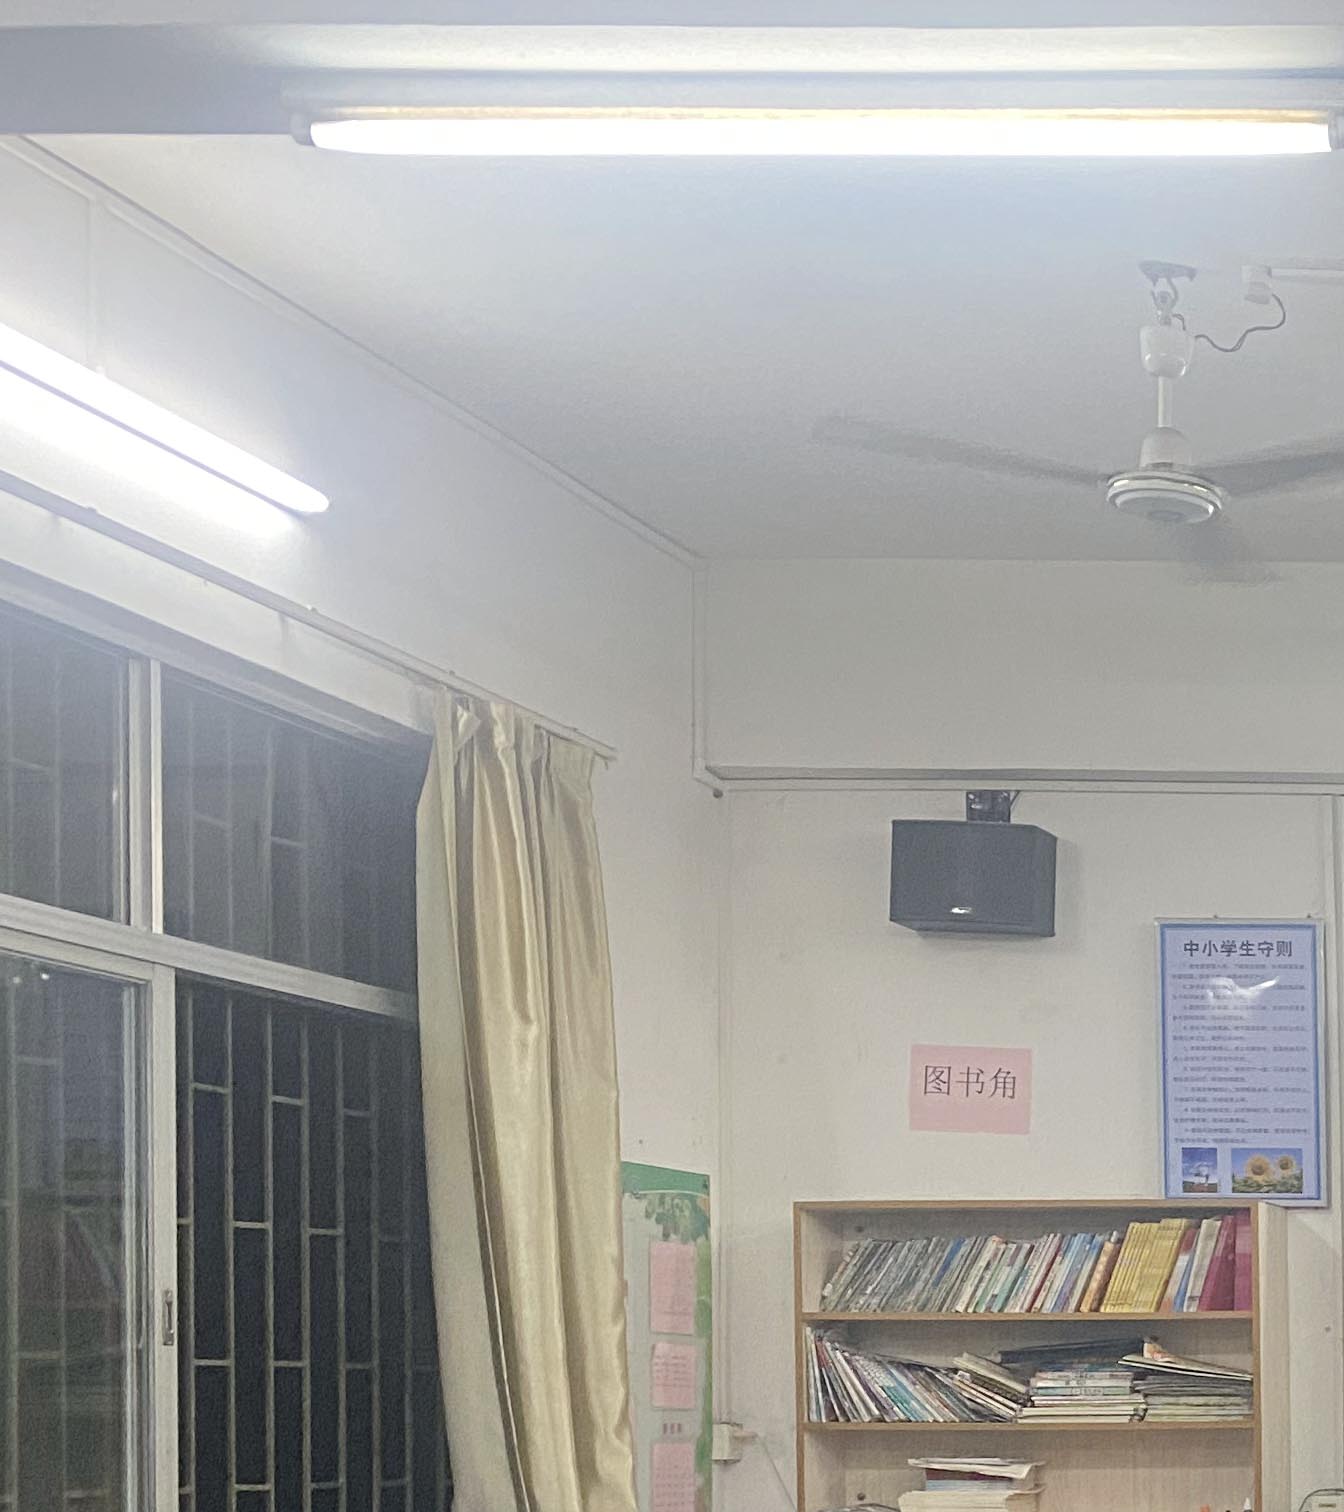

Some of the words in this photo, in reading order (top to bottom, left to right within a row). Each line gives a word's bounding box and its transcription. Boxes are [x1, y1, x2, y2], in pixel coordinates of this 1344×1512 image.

[1183, 940, 1293, 957] 中小学生守则
[923, 1065, 1017, 1100] 图书角
